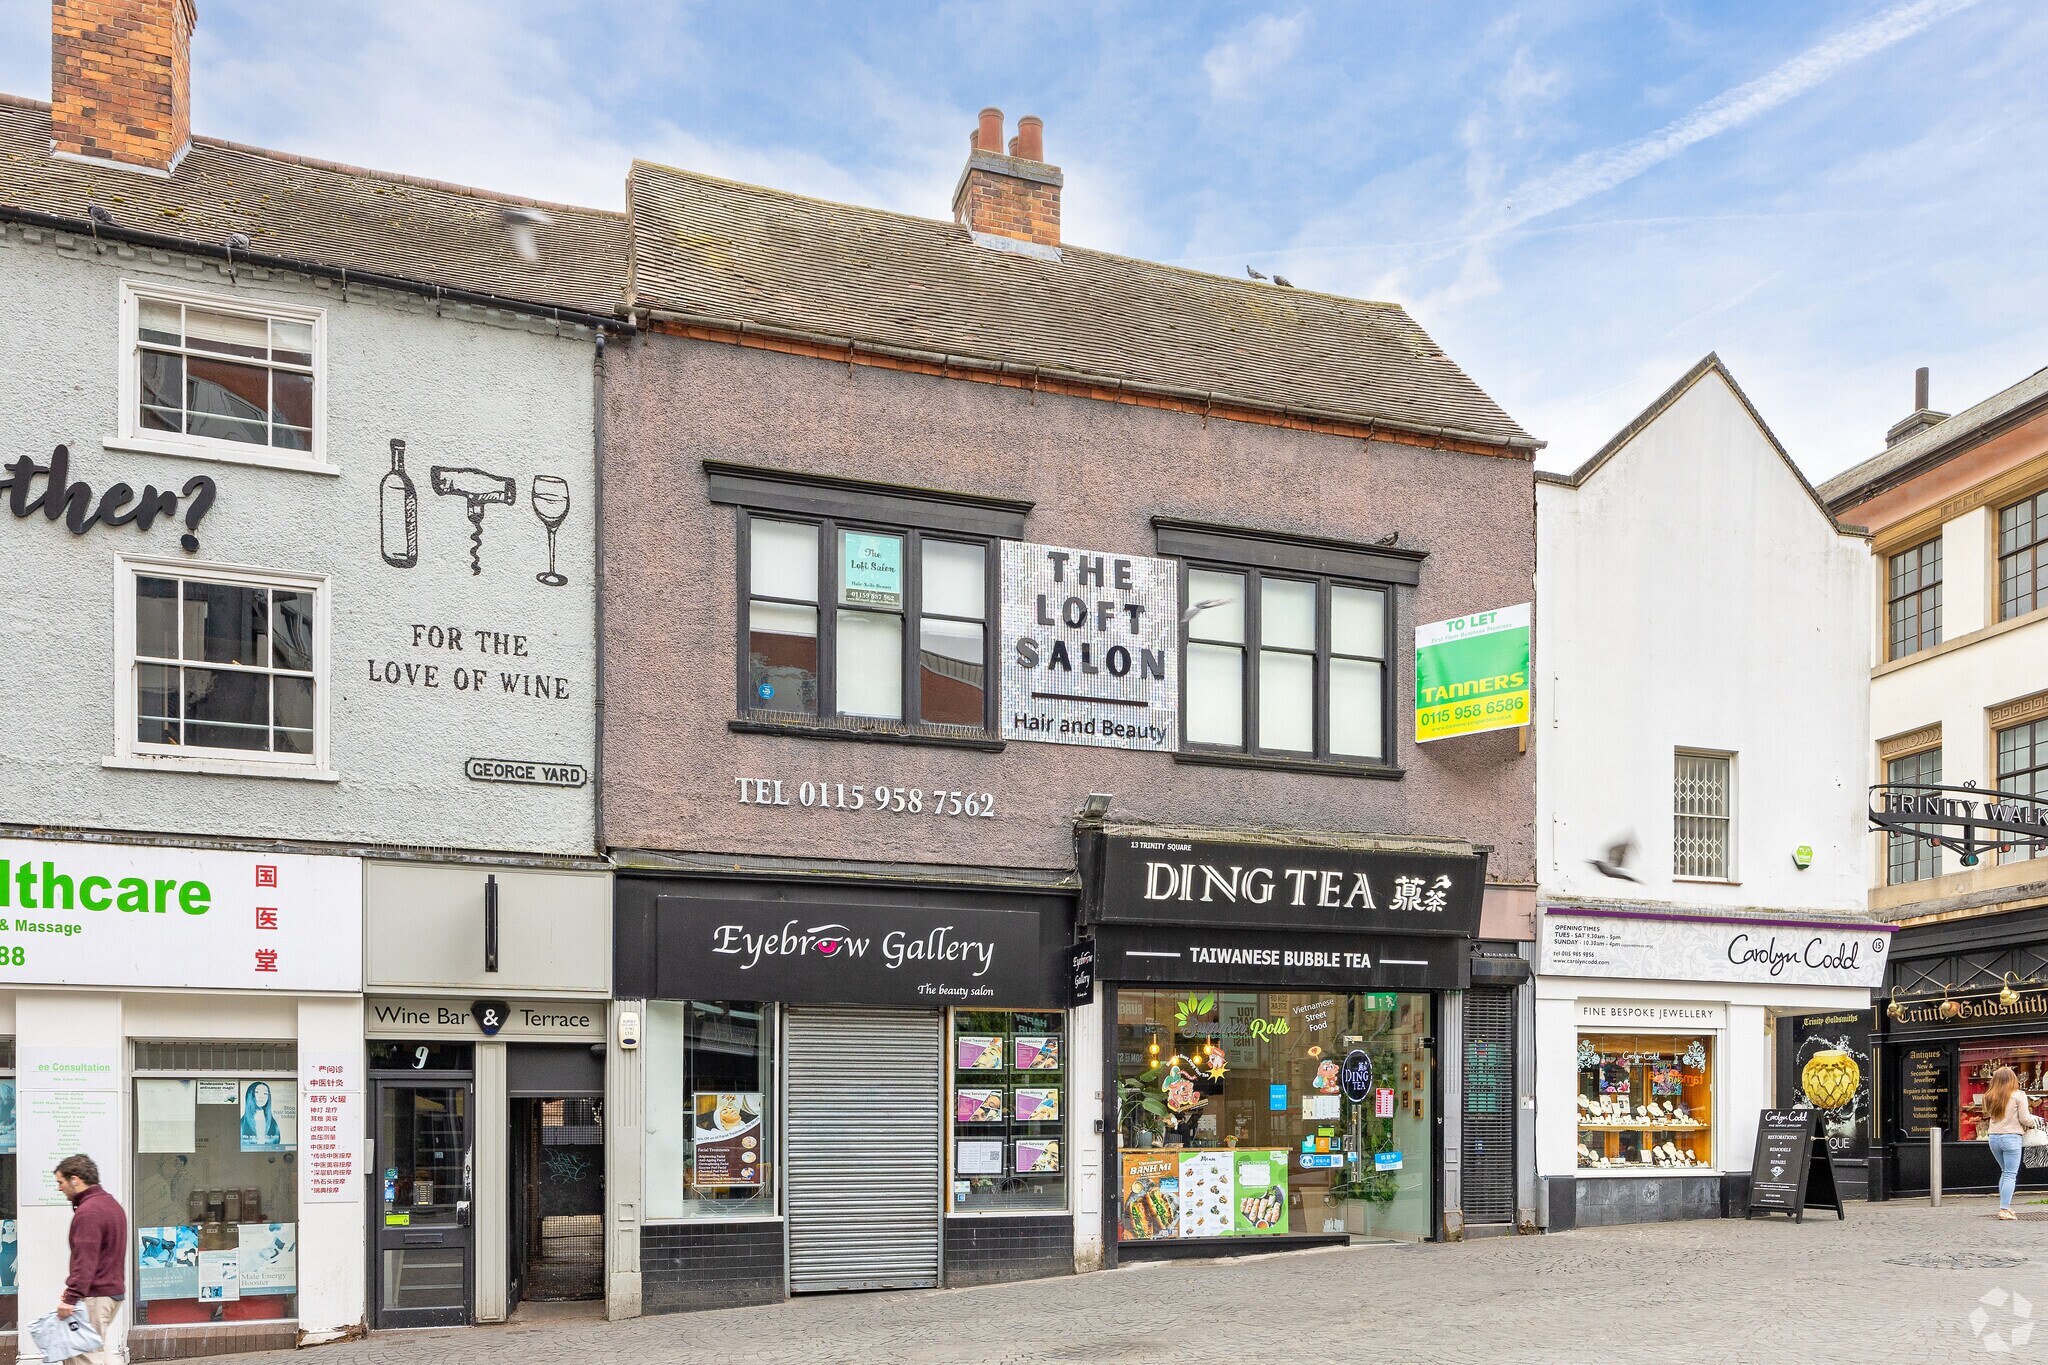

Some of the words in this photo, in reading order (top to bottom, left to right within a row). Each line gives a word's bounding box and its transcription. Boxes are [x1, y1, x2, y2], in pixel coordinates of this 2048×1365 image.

[871, 562, 896, 573] Salon
[1047, 551, 1132, 590] THE
[1037, 594, 1146, 635] LOFT
[1446, 618, 1465, 632] TO
[1470, 612, 1498, 628] LET
[411, 624, 464, 652] FOR
[475, 631, 529, 657] THE
[1460, 629, 1485, 638] Business
[1487, 623, 1512, 632] Premises
[1016, 637, 1166, 681] SALON
[368, 660, 440, 689] LOVE
[454, 667, 486, 692] OF
[500, 673, 571, 700] WINE
[1422, 672, 1524, 703] TANNERS
[1422, 709, 1450, 726] 0115
[1454, 704, 1482, 720] 958
[1486, 696, 1524, 715] 6586
[1014, 712, 1053, 733] Hair
[1060, 716, 1096, 735] and
[1101, 721, 1166, 745] Beauty
[473, 762, 536, 781] GEORGE
[542, 767, 580, 783] YARD
[734, 777, 790, 807] TEL
[799, 781, 865, 810] 0115
[874, 786, 923, 815] 958
[933, 790, 995, 819] 7562
[1886, 793, 1979, 818] TRINITY
[1984, 803, 2048, 827] WALK
[1140, 842, 1166, 850] TRINITY
[1167, 844, 1192, 852] SQUARE
[1143, 861, 1277, 904] DING
[1284, 869, 1377, 910] TEA
[15, 919, 82, 937] Massage
[712, 920, 870, 970] Eyebrow
[882, 926, 995, 977] Gallery
[1190, 947, 1280, 966] TAIWANESE
[1284, 950, 1340, 968] BUBBLE
[1345, 951, 1371, 968] TEA
[1728, 934, 1801, 976] Carolyn
[1804, 938, 1860, 969] Codd
[917, 984, 936, 996] The
[938, 985, 969, 998] beauty
[971, 986, 994, 996] salon
[375, 1006, 430, 1024] Wine
[437, 1008, 470, 1025] Bar
[483, 1009, 499, 1027] &
[520, 1009, 590, 1027] Terrace
[1292, 998, 1334, 1014] Vietnamese
[1306, 1011, 1327, 1022] Street
[1583, 1006, 1607, 1018] FINE
[1610, 1007, 1654, 1018] BESPOKE
[1658, 1008, 1714, 1020] JEWELLERY
[1250, 1018, 1290, 1042] Rolls
[1309, 1021, 1328, 1032] Food
[1804, 1017, 1824, 1026] Trinity
[1825, 1014, 1858, 1024] Goldsmiths
[412, 1046, 429, 1069] 9
[1910, 1050, 1940, 1059] Antiques
[52, 1062, 110, 1072] Consultation
[1346, 1070, 1368, 1082] DING
[1352, 1082, 1366, 1090] TEA
[1765, 1111, 1788, 1124] Carolyn
[1789, 1111, 1808, 1122] Codd
[262, 1272, 287, 1280] Energy
